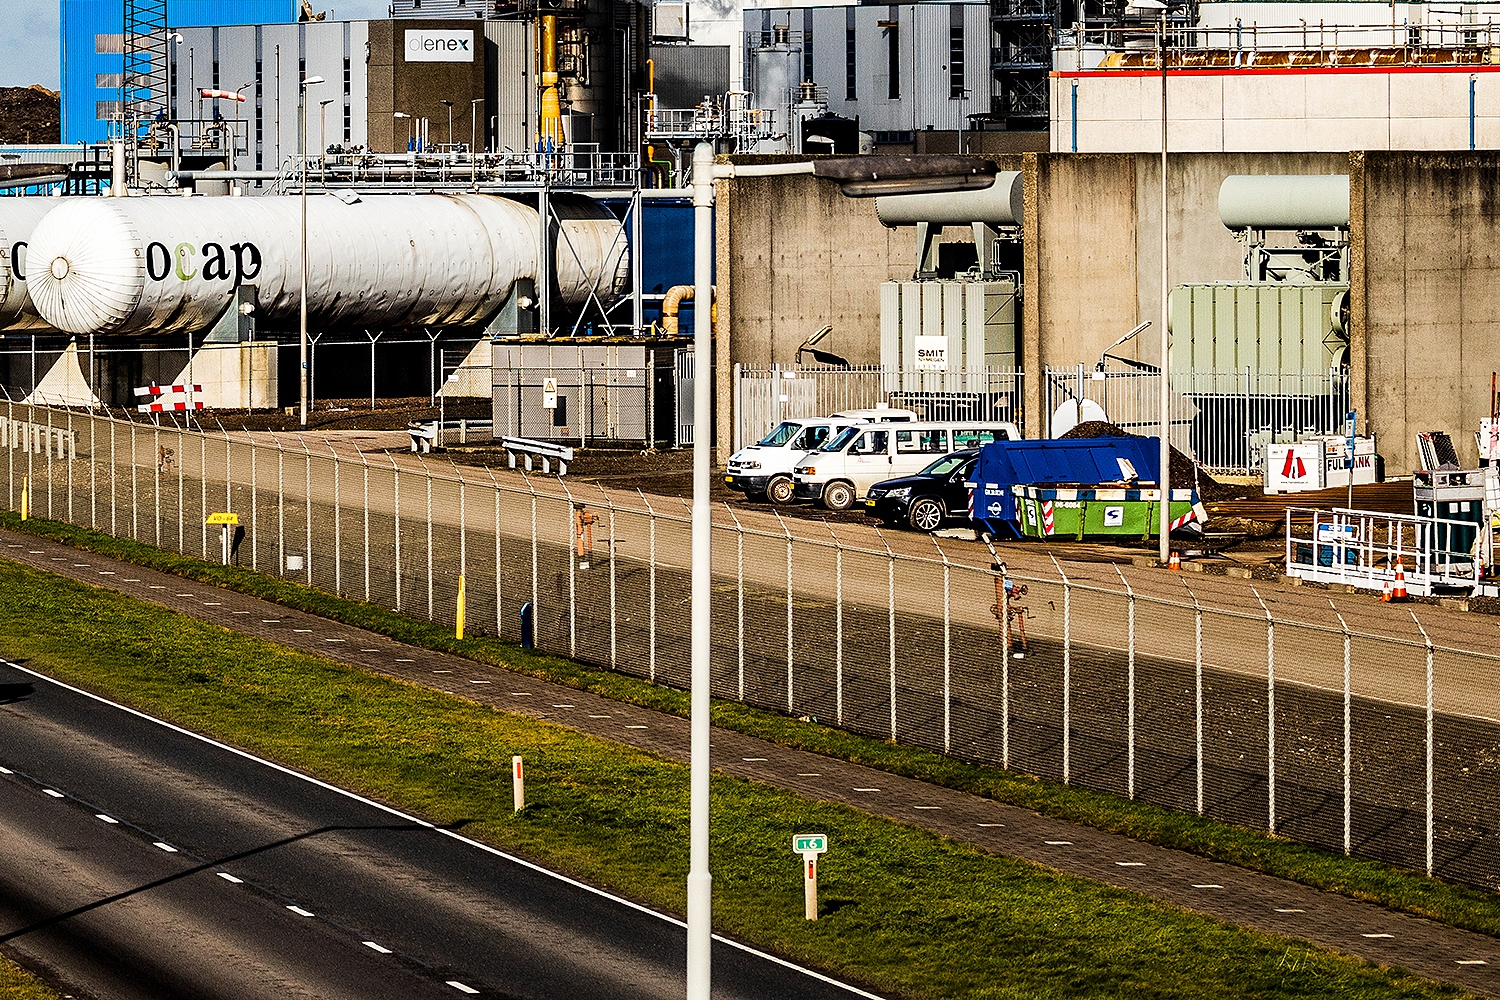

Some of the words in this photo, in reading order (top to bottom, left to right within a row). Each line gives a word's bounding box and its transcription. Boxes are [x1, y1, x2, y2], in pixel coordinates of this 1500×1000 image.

[409, 34, 469, 51] olenex
[146, 241, 262, 295] ocap
[917, 349, 945, 357] SMIT
